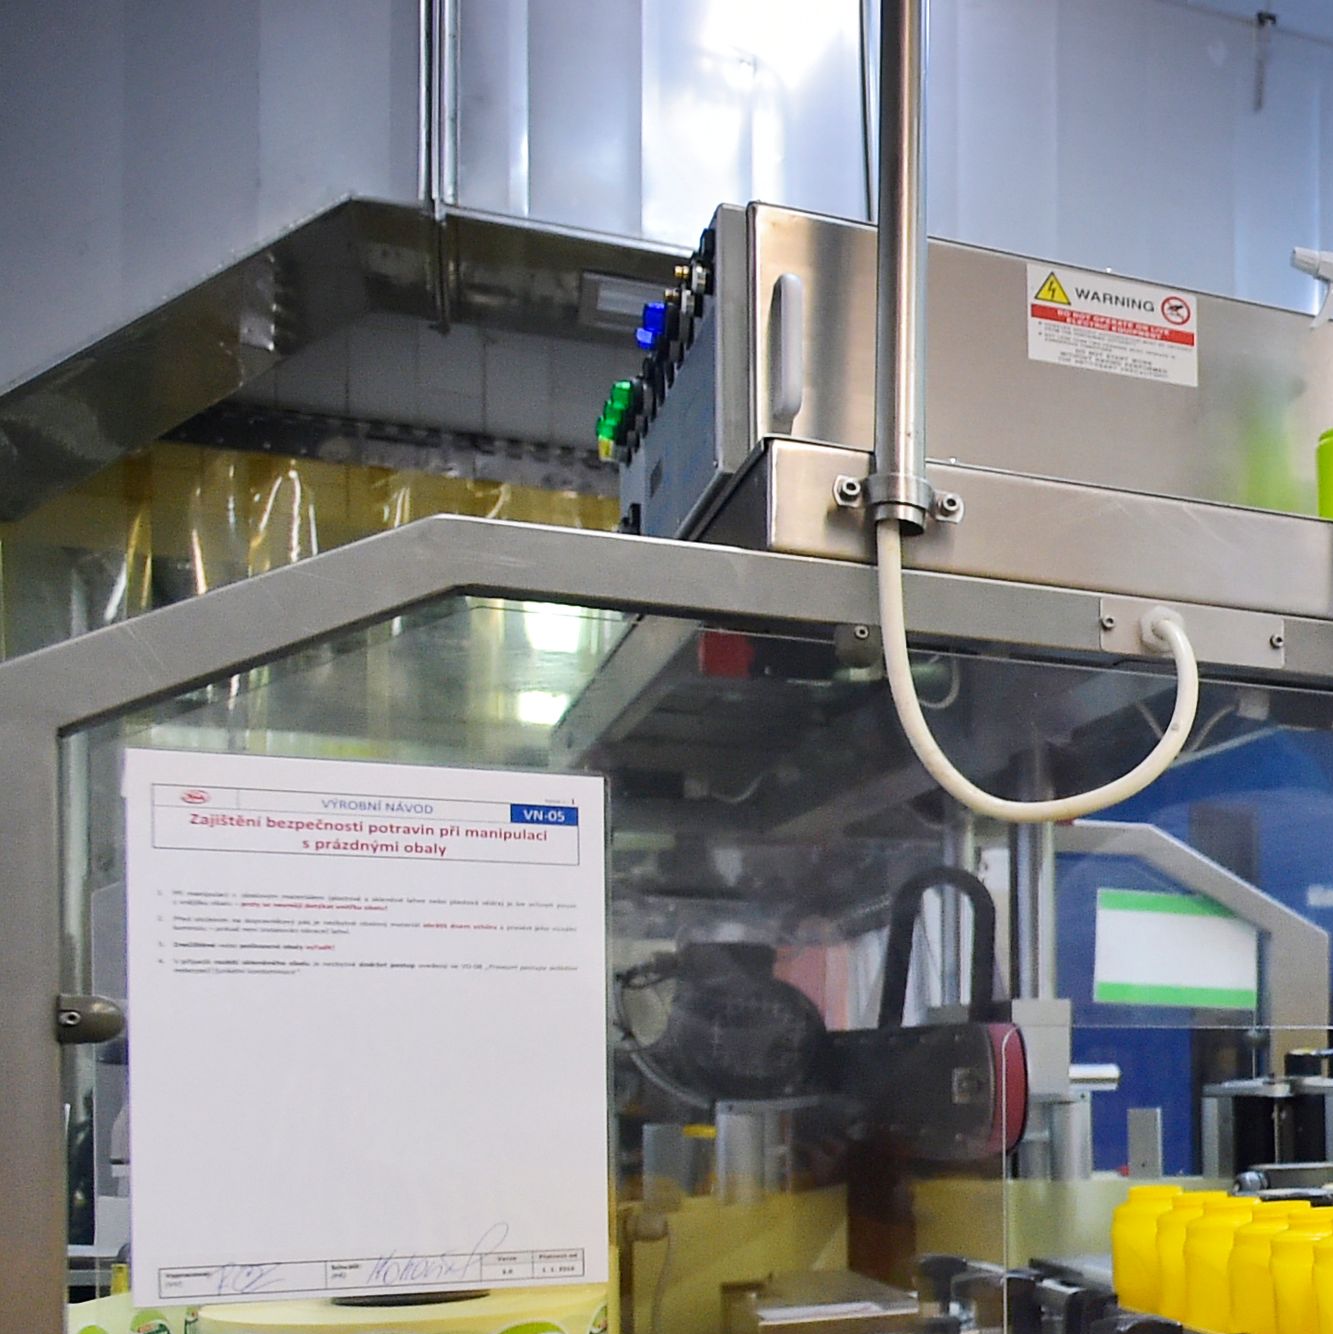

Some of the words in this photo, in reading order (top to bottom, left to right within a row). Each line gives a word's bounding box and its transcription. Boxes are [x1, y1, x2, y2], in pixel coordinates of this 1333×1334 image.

[1075, 287, 1155, 313] WARNING
[321, 797, 382, 812] VÝROBNÍ
[385, 800, 434, 815] NÁVOD
[523, 809, 565, 822] VN-05
[190, 812, 261, 830] Zajištění
[266, 816, 363, 833] bezpečnosti
[368, 822, 434, 837] potravin
[440, 824, 460, 838] při
[465, 827, 548, 842] manipulaci
[302, 839, 310, 849] s
[315, 837, 399, 855] prázdnými
[404, 841, 447, 857] obaly
